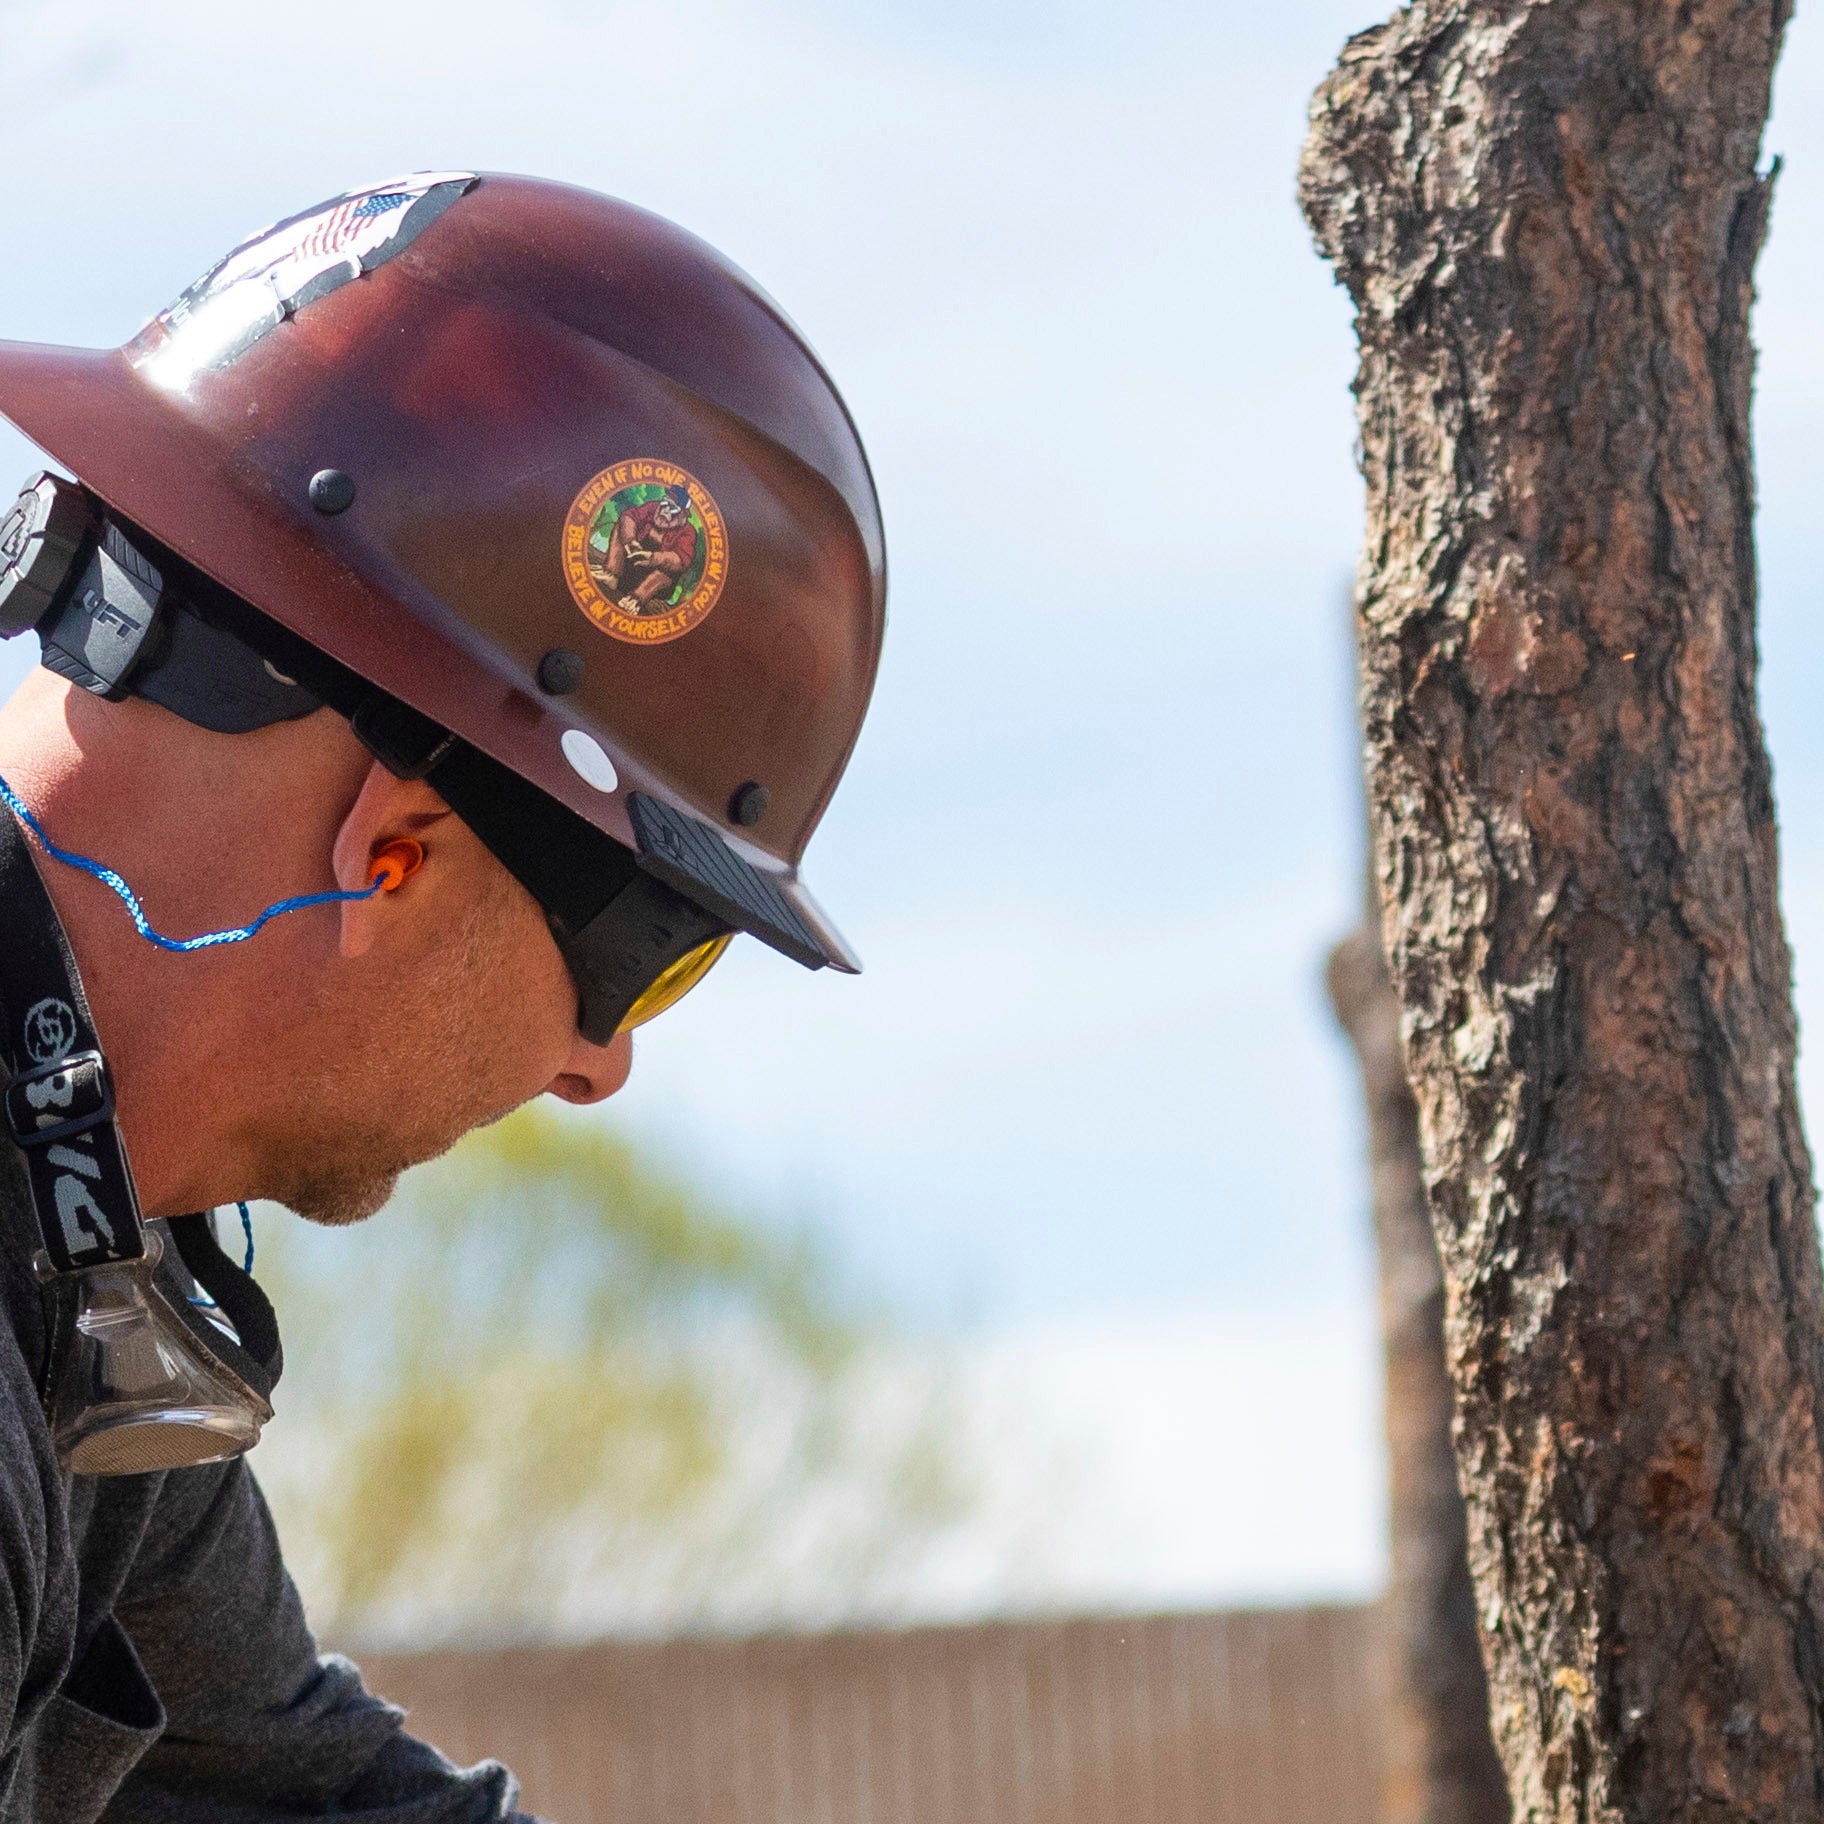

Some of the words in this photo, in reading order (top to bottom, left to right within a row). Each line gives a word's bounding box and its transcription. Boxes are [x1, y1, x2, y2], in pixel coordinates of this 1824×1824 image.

[615, 467, 628, 484] IF
[631, 463, 652, 480] NO
[655, 466, 686, 487] ONE
[579, 472, 613, 514] EVEN
[687, 483, 723, 559] BELIEVES
[568, 524, 595, 604] BELIEVE
[589, 601, 608, 621] IN
[609, 611, 688, 639] YOURSELF
[710, 562, 723, 579] IN
[694, 582, 717, 612] YOU
